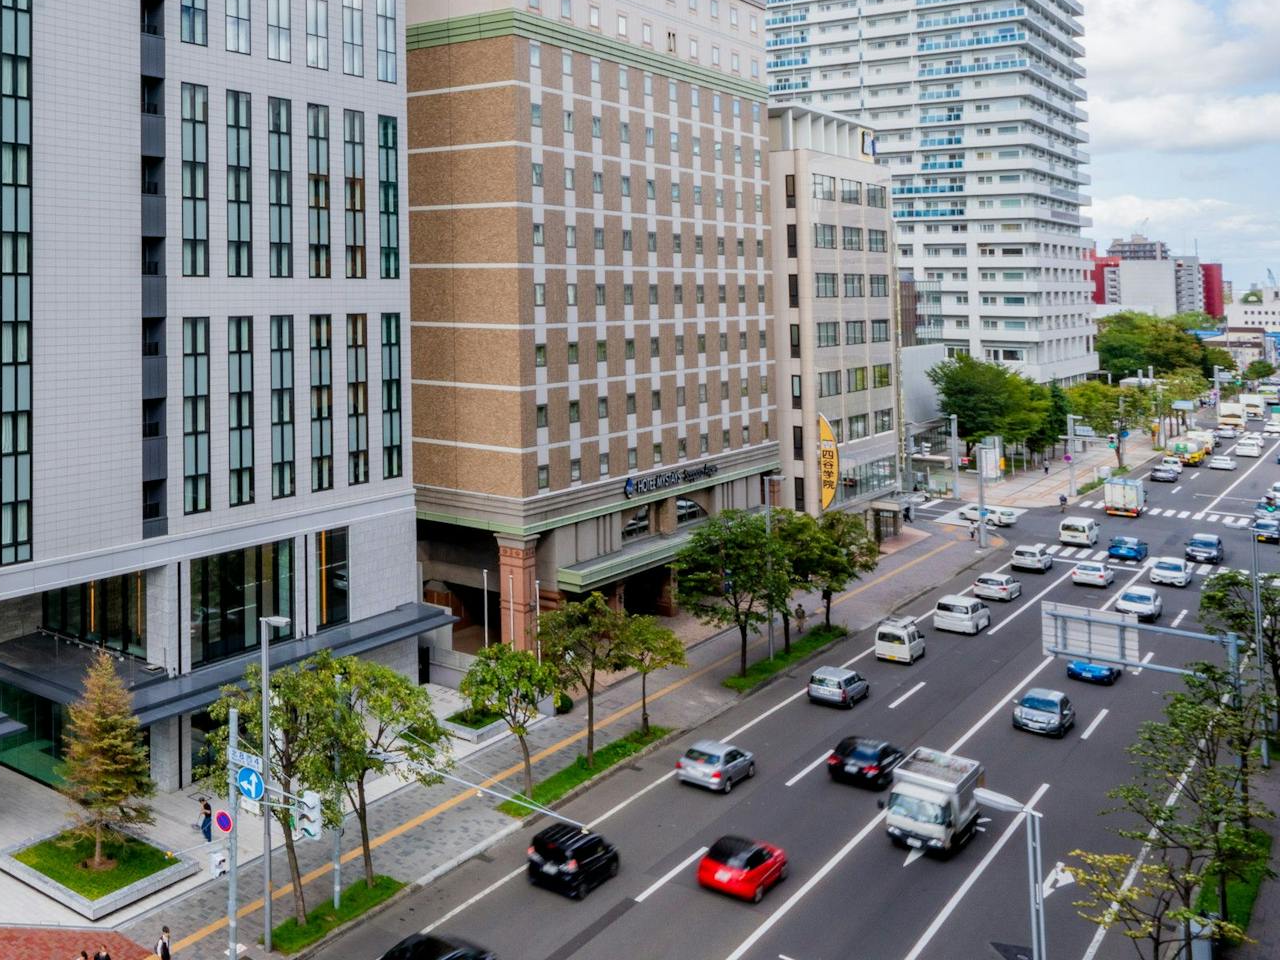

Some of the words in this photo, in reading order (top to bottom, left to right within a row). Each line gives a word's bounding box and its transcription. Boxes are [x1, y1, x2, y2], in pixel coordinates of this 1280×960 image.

[822, 450, 835, 489] 四谷学院
[637, 478, 656, 493] HOTEL
